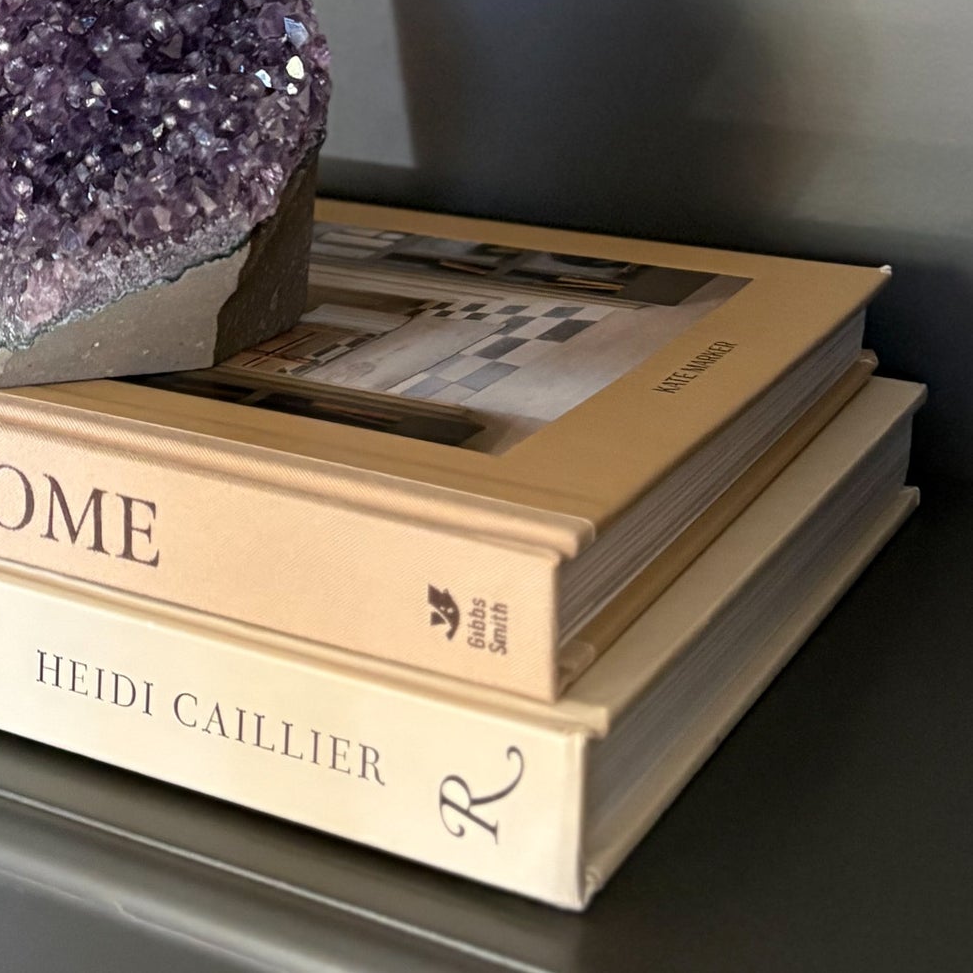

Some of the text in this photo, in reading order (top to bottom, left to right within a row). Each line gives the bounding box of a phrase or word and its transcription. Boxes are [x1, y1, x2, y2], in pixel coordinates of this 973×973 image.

[651, 341, 738, 394] KATE MARKER
[467, 597, 487, 649] Gibbs
[488, 602, 508, 655] Smith
[36, 649, 385, 786] HEIDI CAILLIER
[439, 745, 525, 845] R
